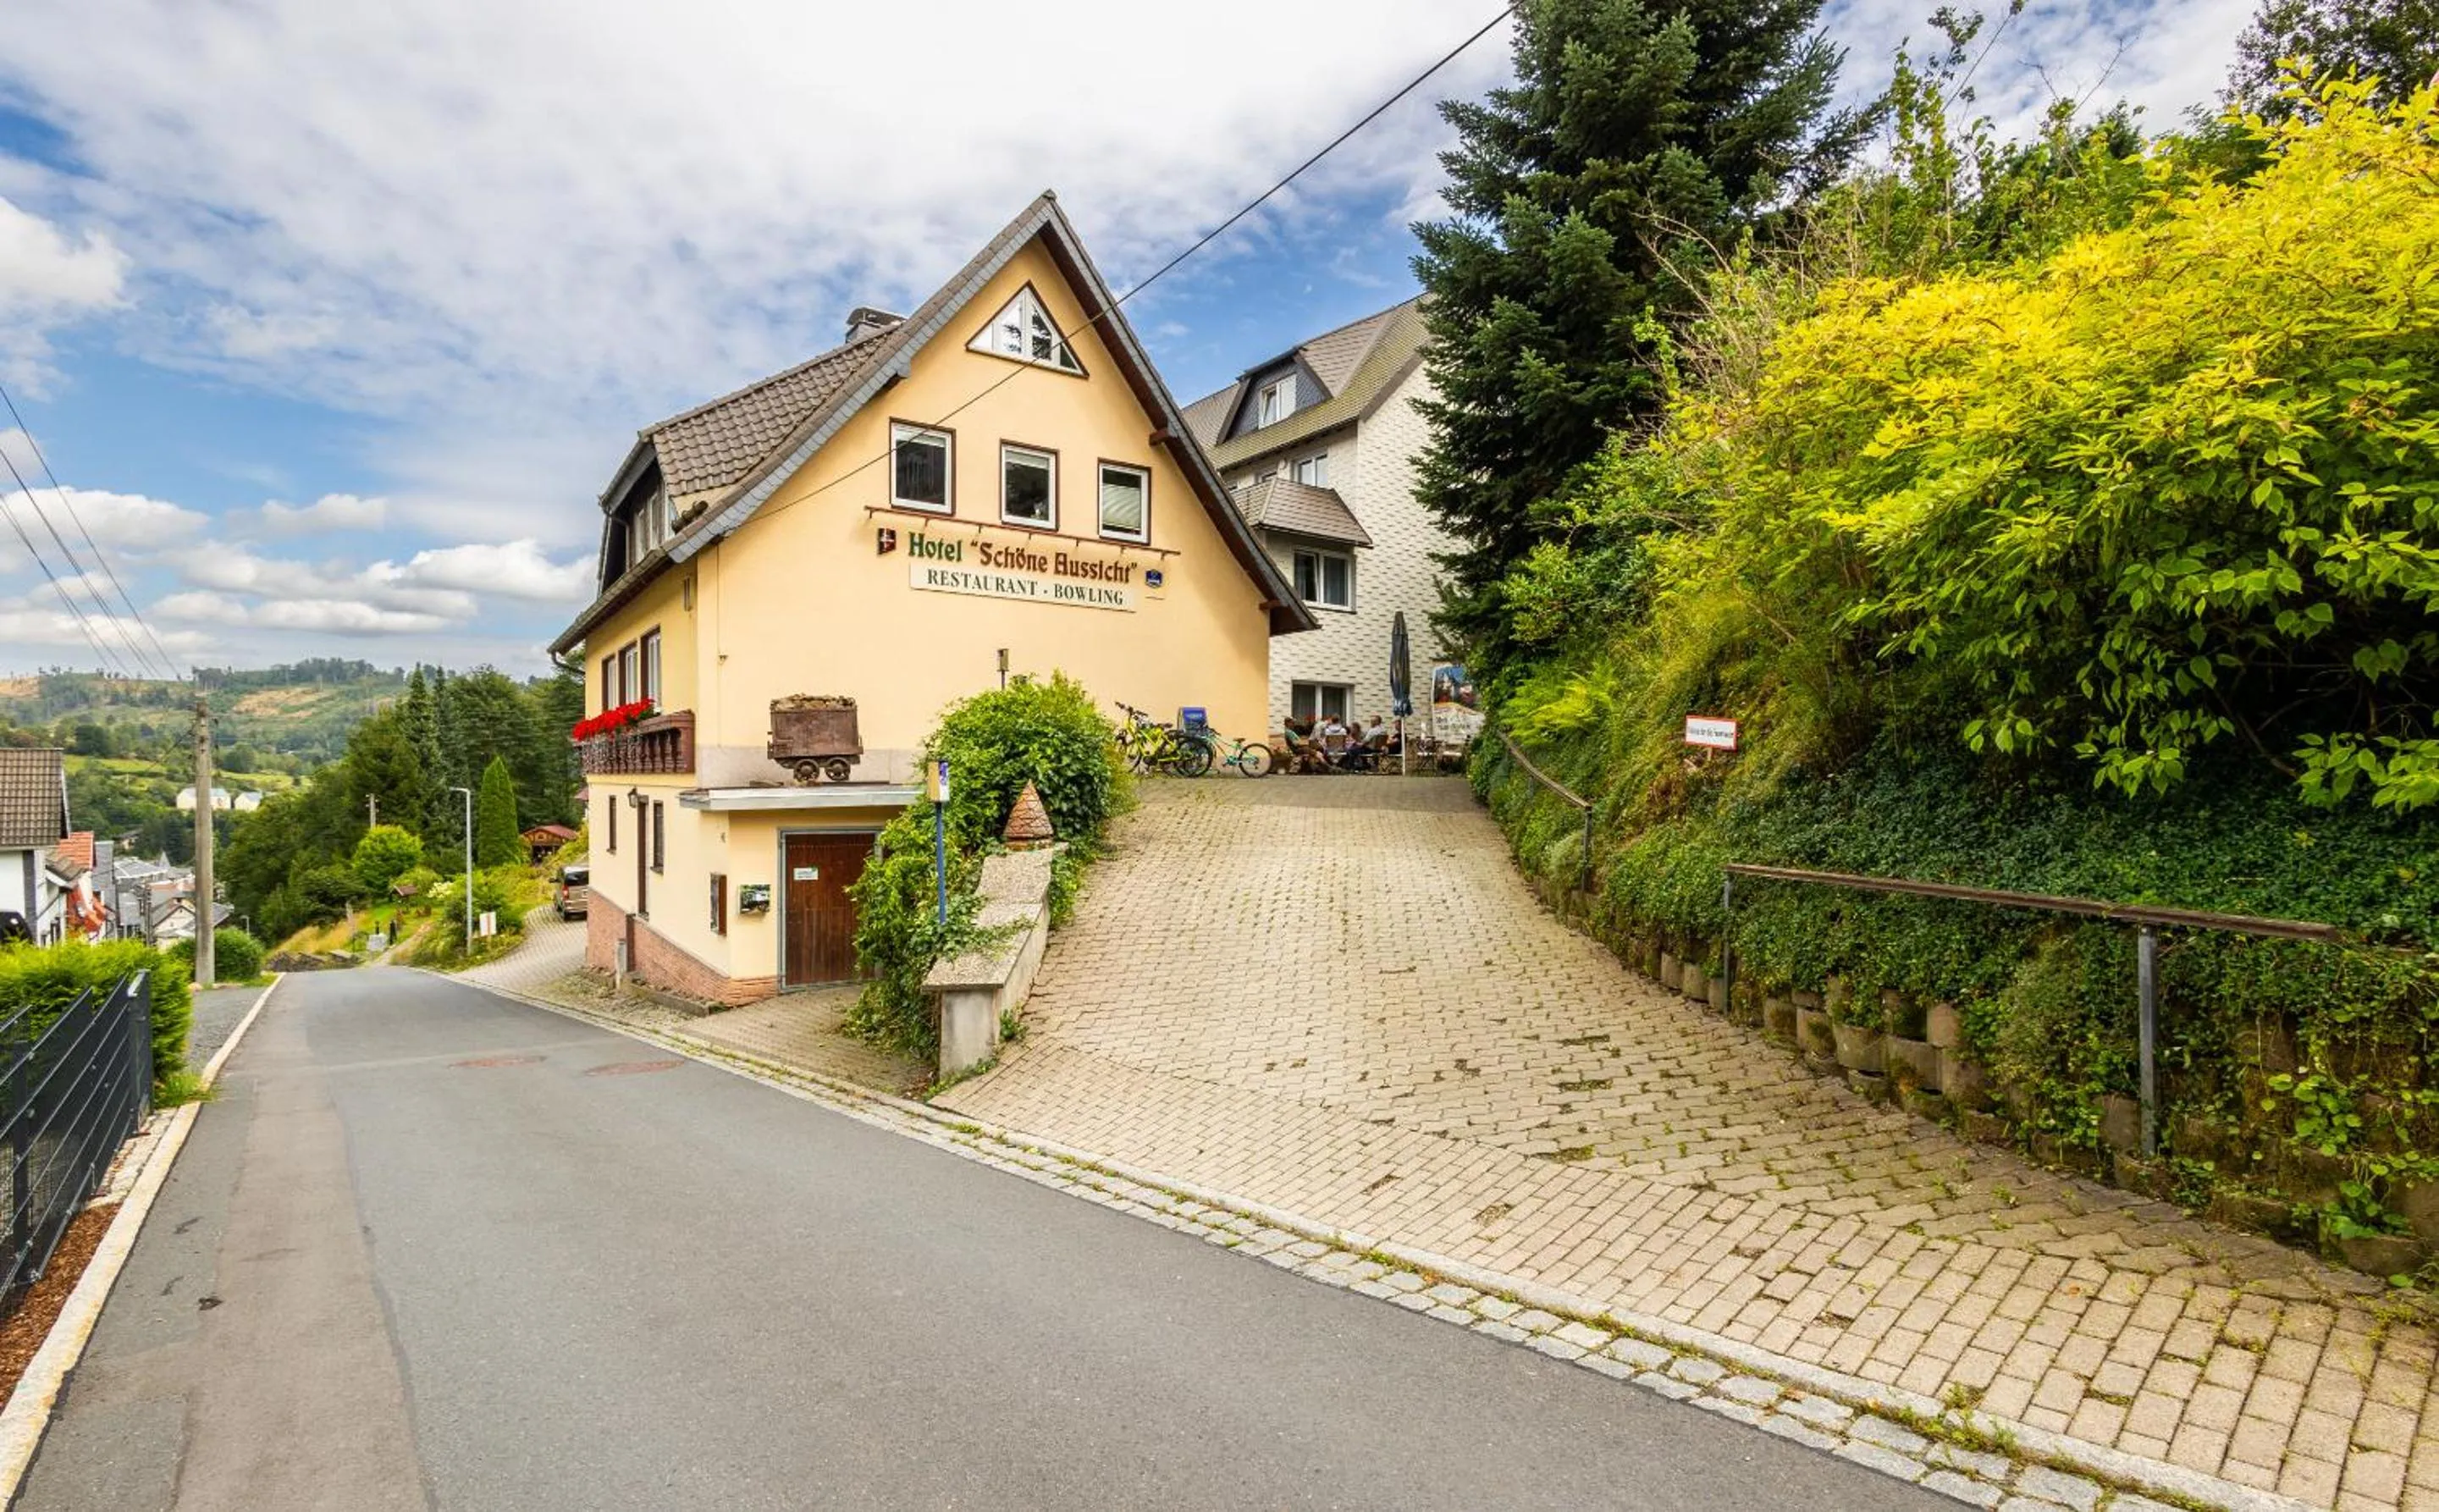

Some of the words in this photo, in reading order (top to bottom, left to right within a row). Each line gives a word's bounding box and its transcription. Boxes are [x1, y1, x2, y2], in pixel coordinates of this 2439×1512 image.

[908, 531, 963, 562] Hotel
[926, 568, 1038, 595] RESTAURANT
[1054, 582, 1123, 605] BOWLING
